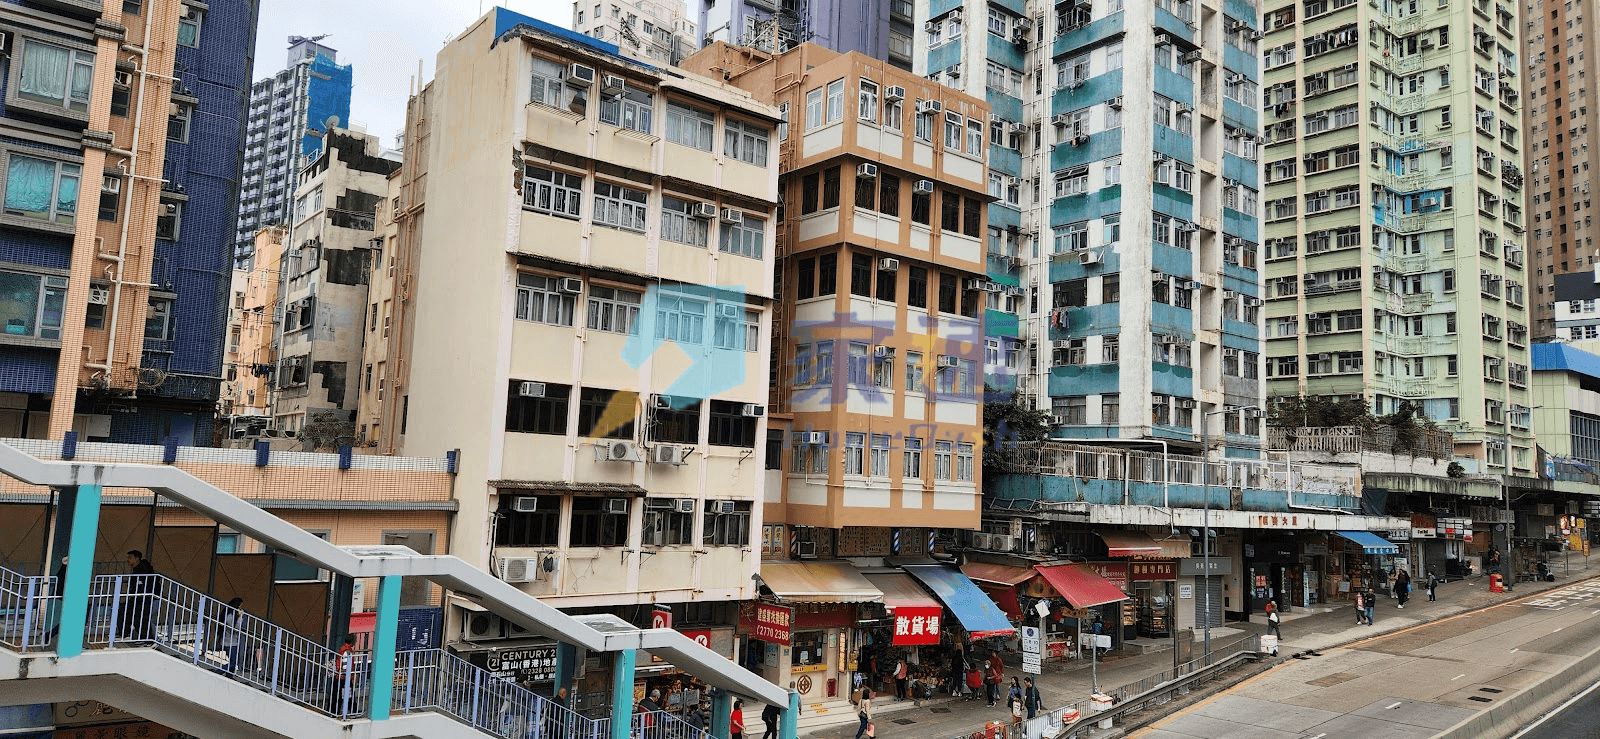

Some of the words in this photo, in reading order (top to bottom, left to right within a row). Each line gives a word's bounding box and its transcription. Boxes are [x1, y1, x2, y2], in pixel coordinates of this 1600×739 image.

[896, 616, 939, 636] 散貨場
[502, 649, 548, 660] CENTURY
